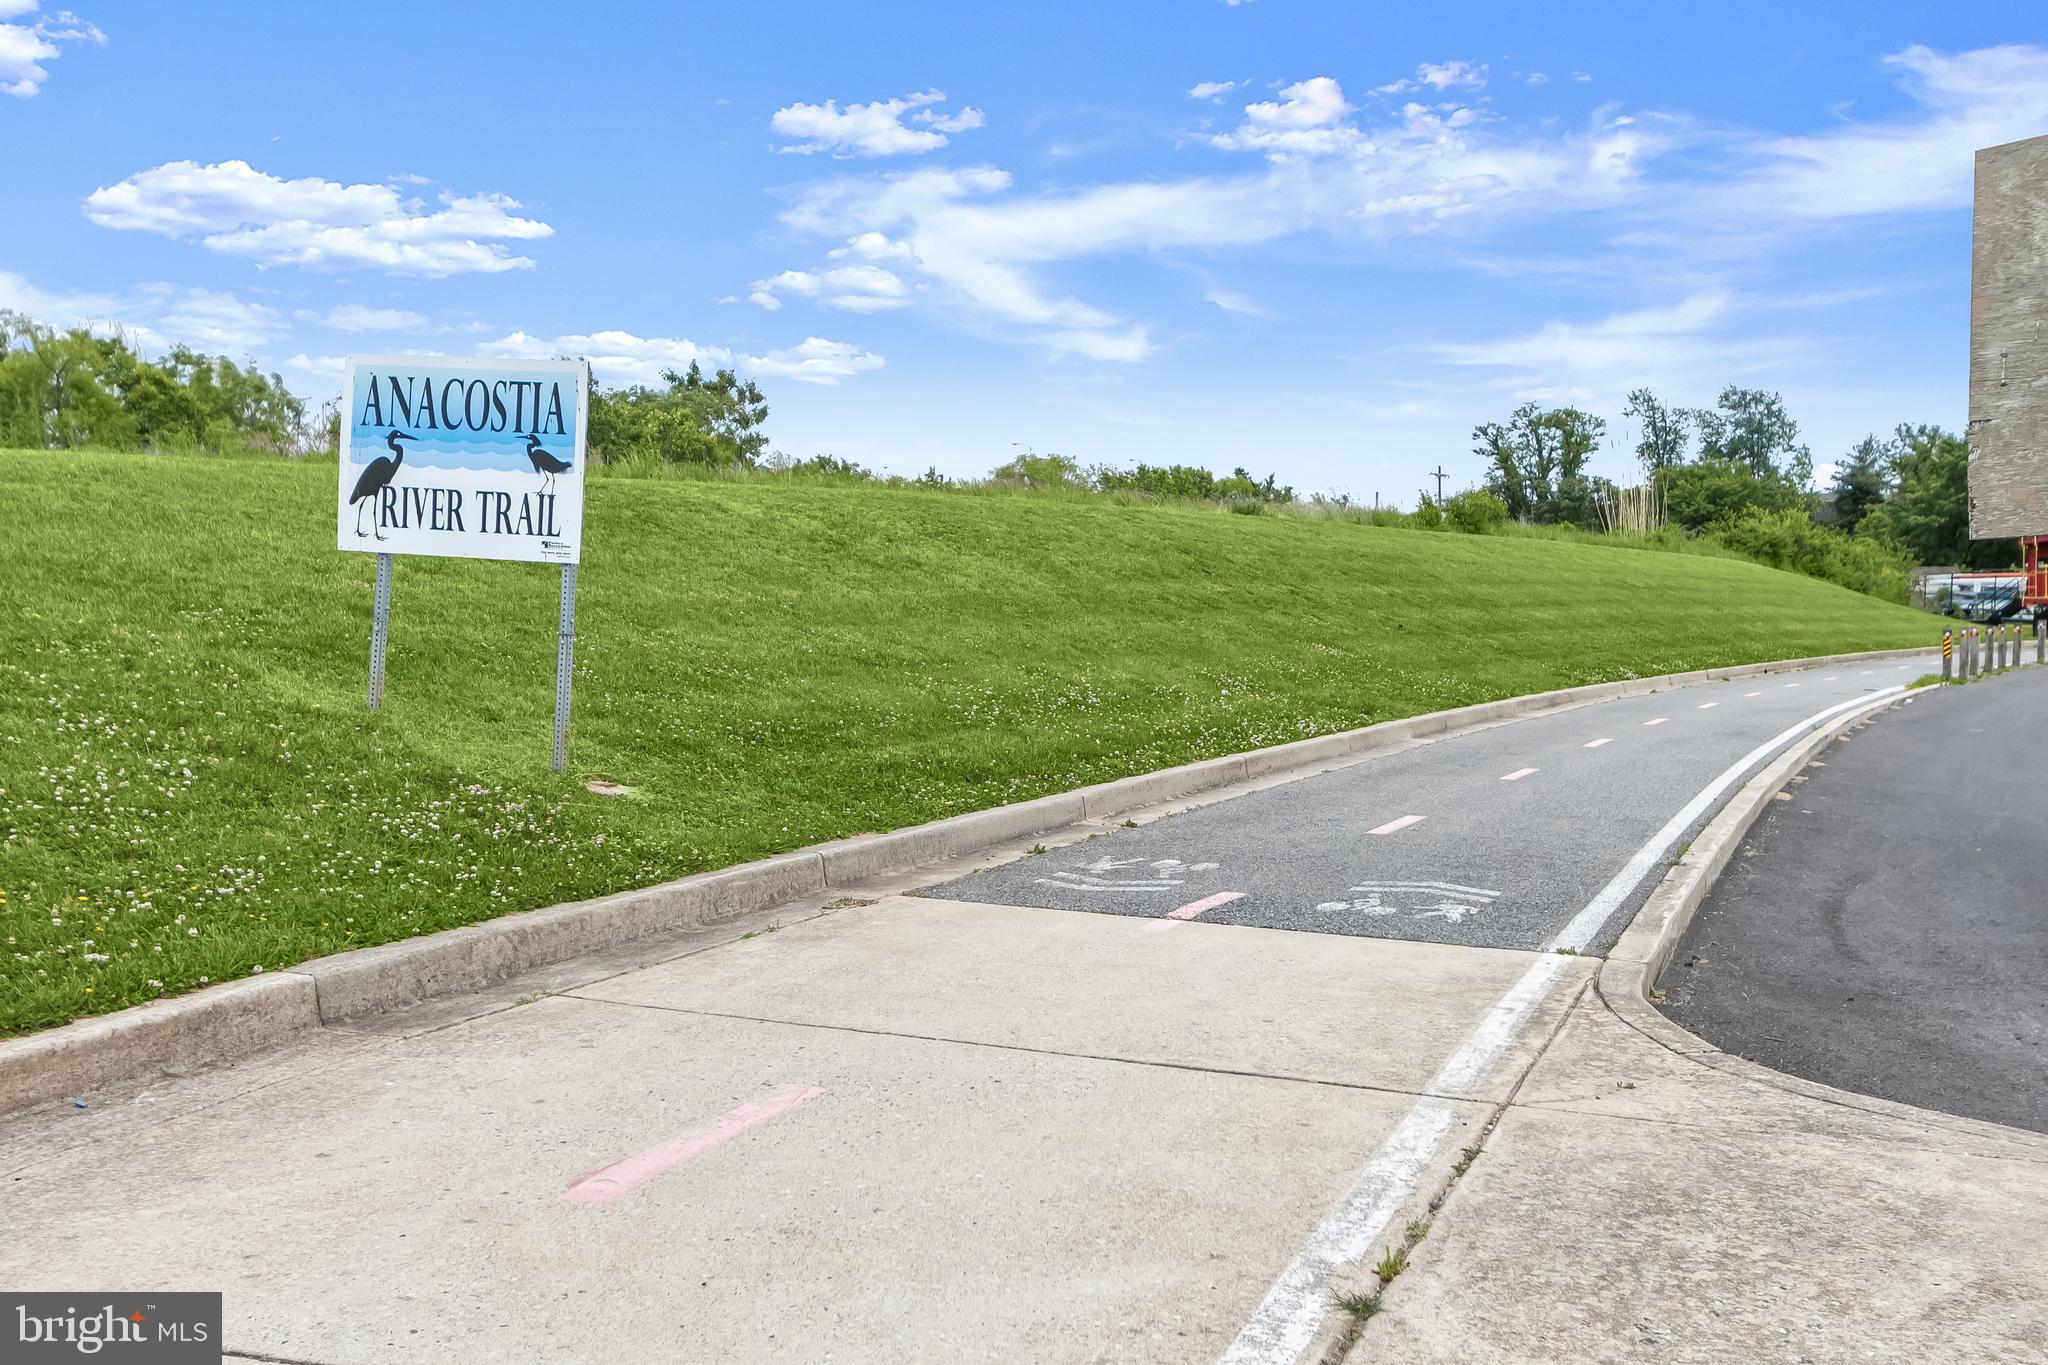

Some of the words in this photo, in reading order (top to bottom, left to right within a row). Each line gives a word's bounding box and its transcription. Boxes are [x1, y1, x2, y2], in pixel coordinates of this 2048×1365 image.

[360, 375, 567, 435] ANACOSTIA
[380, 485, 465, 532] RIVER
[475, 490, 561, 537] TRAIL
